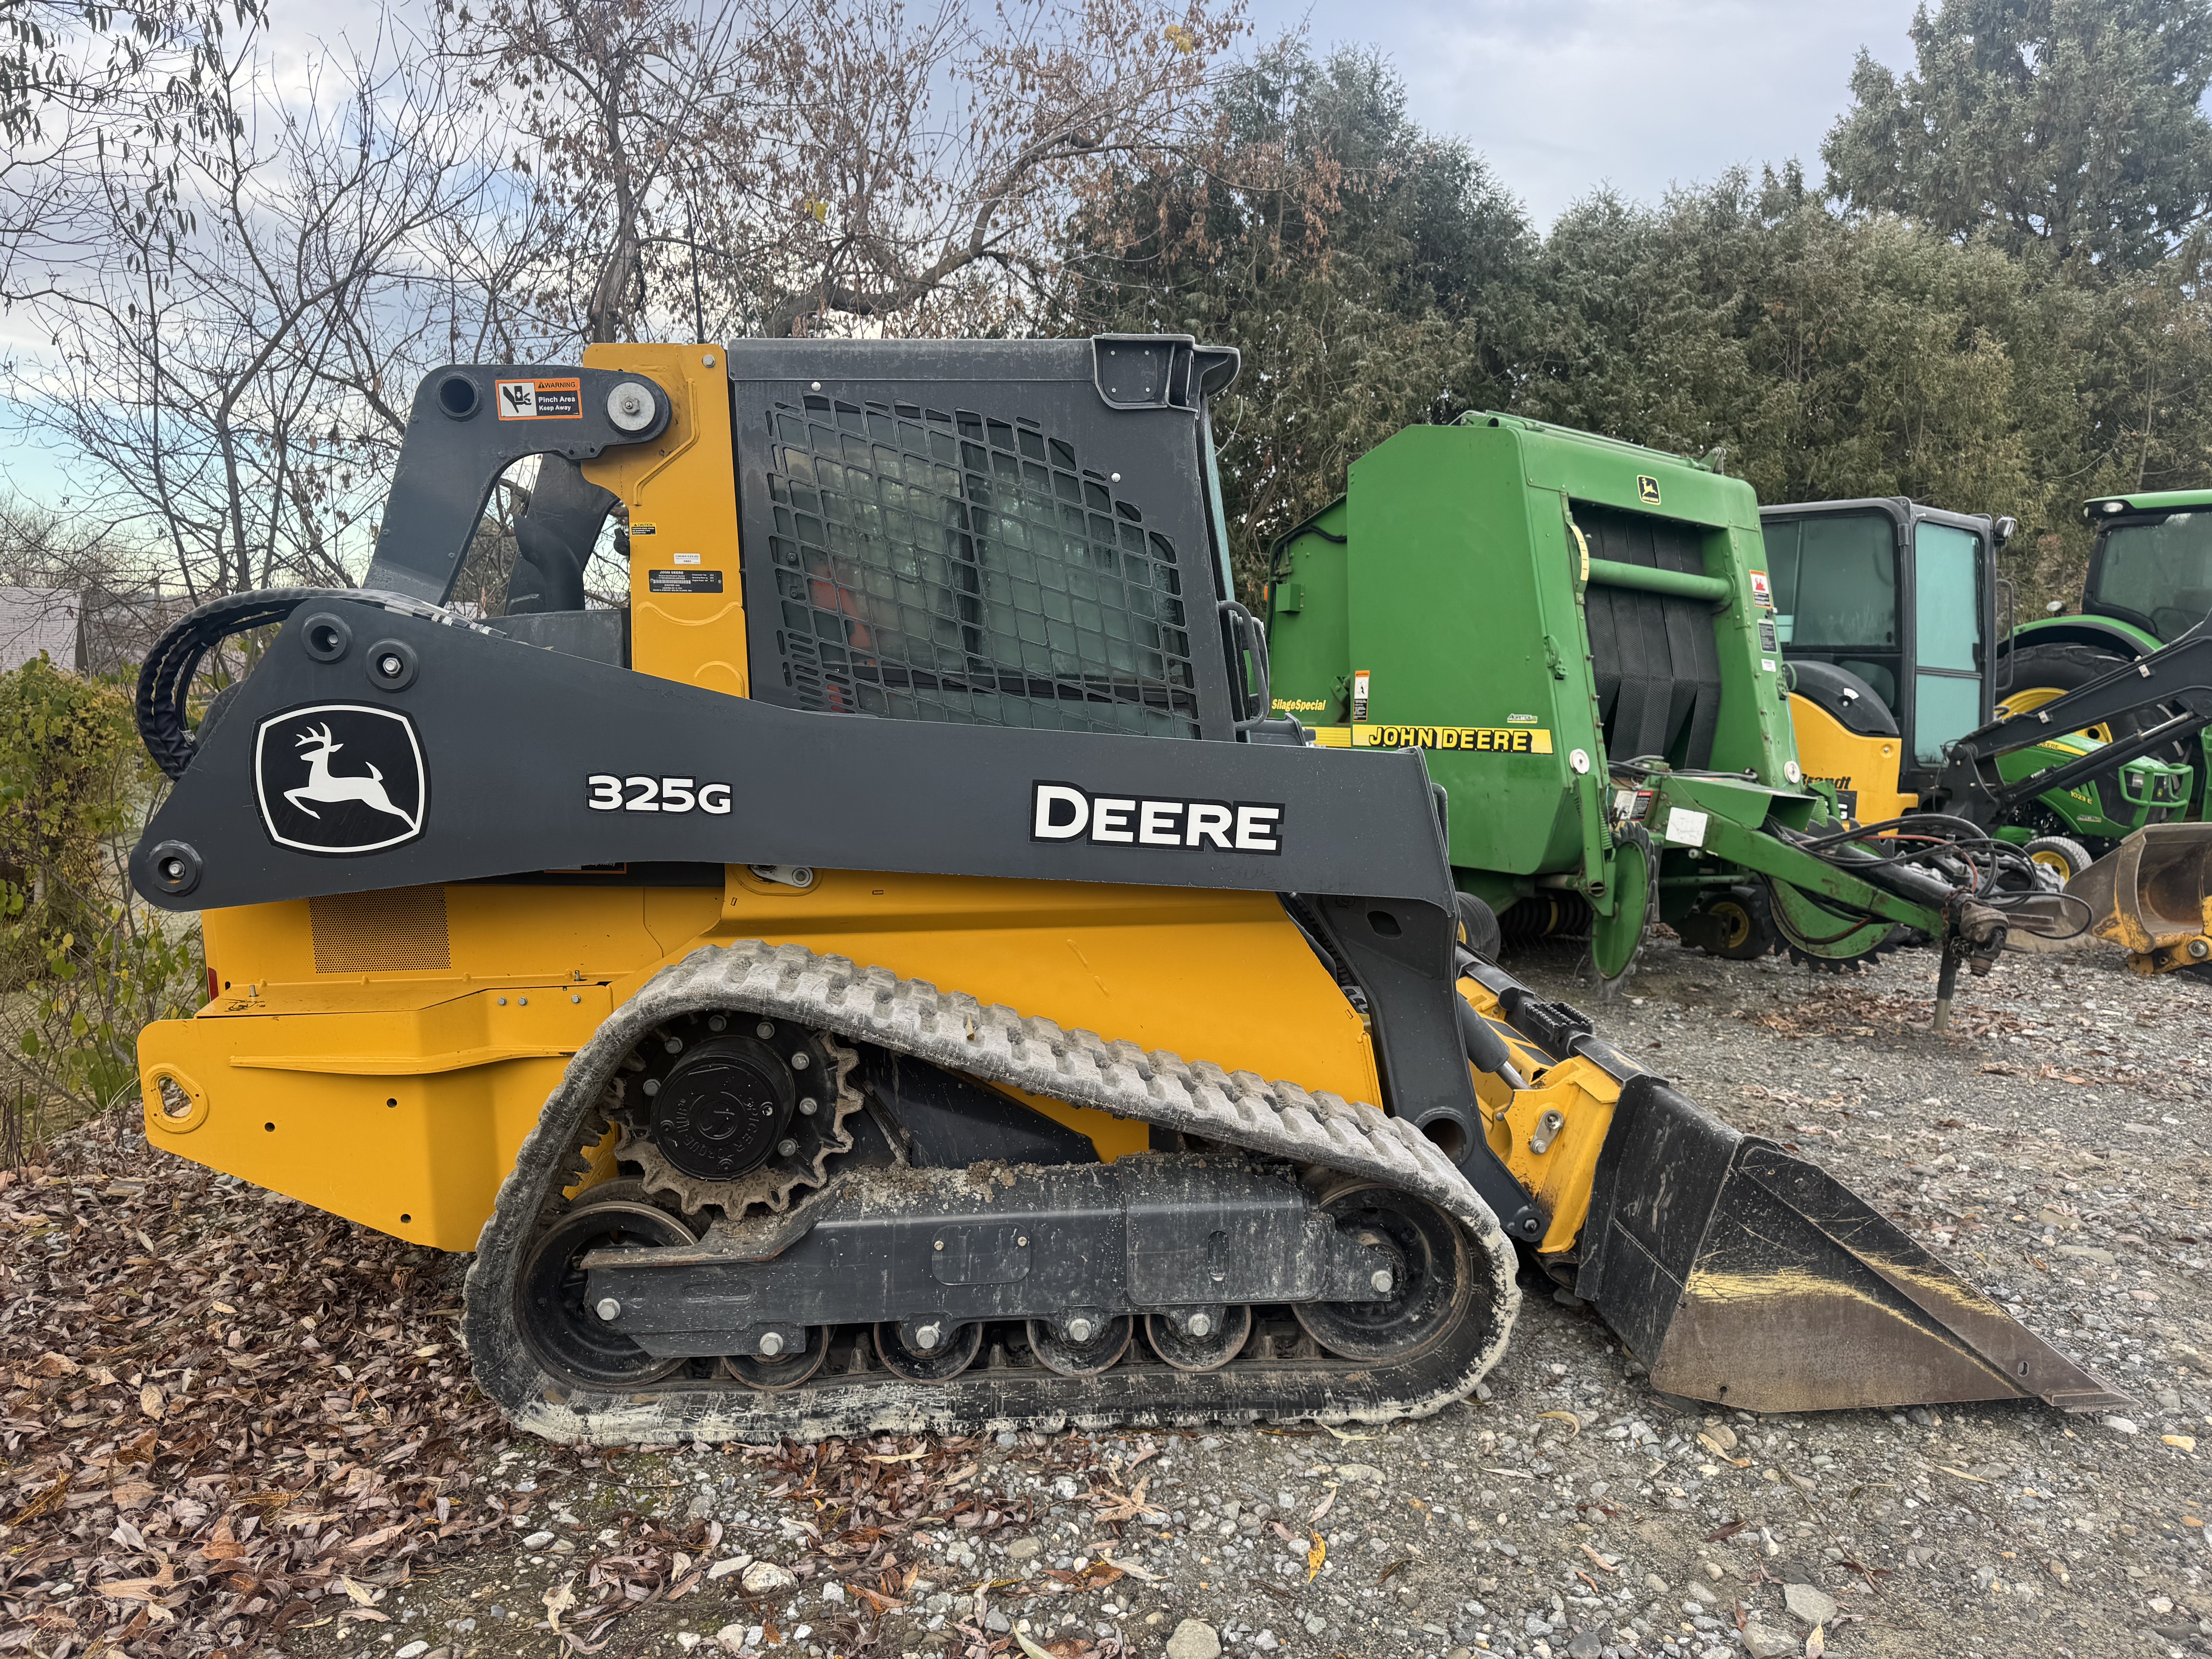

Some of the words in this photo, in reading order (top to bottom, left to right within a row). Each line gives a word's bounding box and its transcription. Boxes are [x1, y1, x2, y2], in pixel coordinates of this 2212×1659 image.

[1272, 699, 1326, 712] SilageSpecial
[1369, 727, 1434, 747] JOHN
[1443, 729, 1528, 751] DEERE
[588, 775, 731, 814] 325G
[2071, 791, 2086, 802] 1023
[1034, 784, 1279, 851] DEERE
